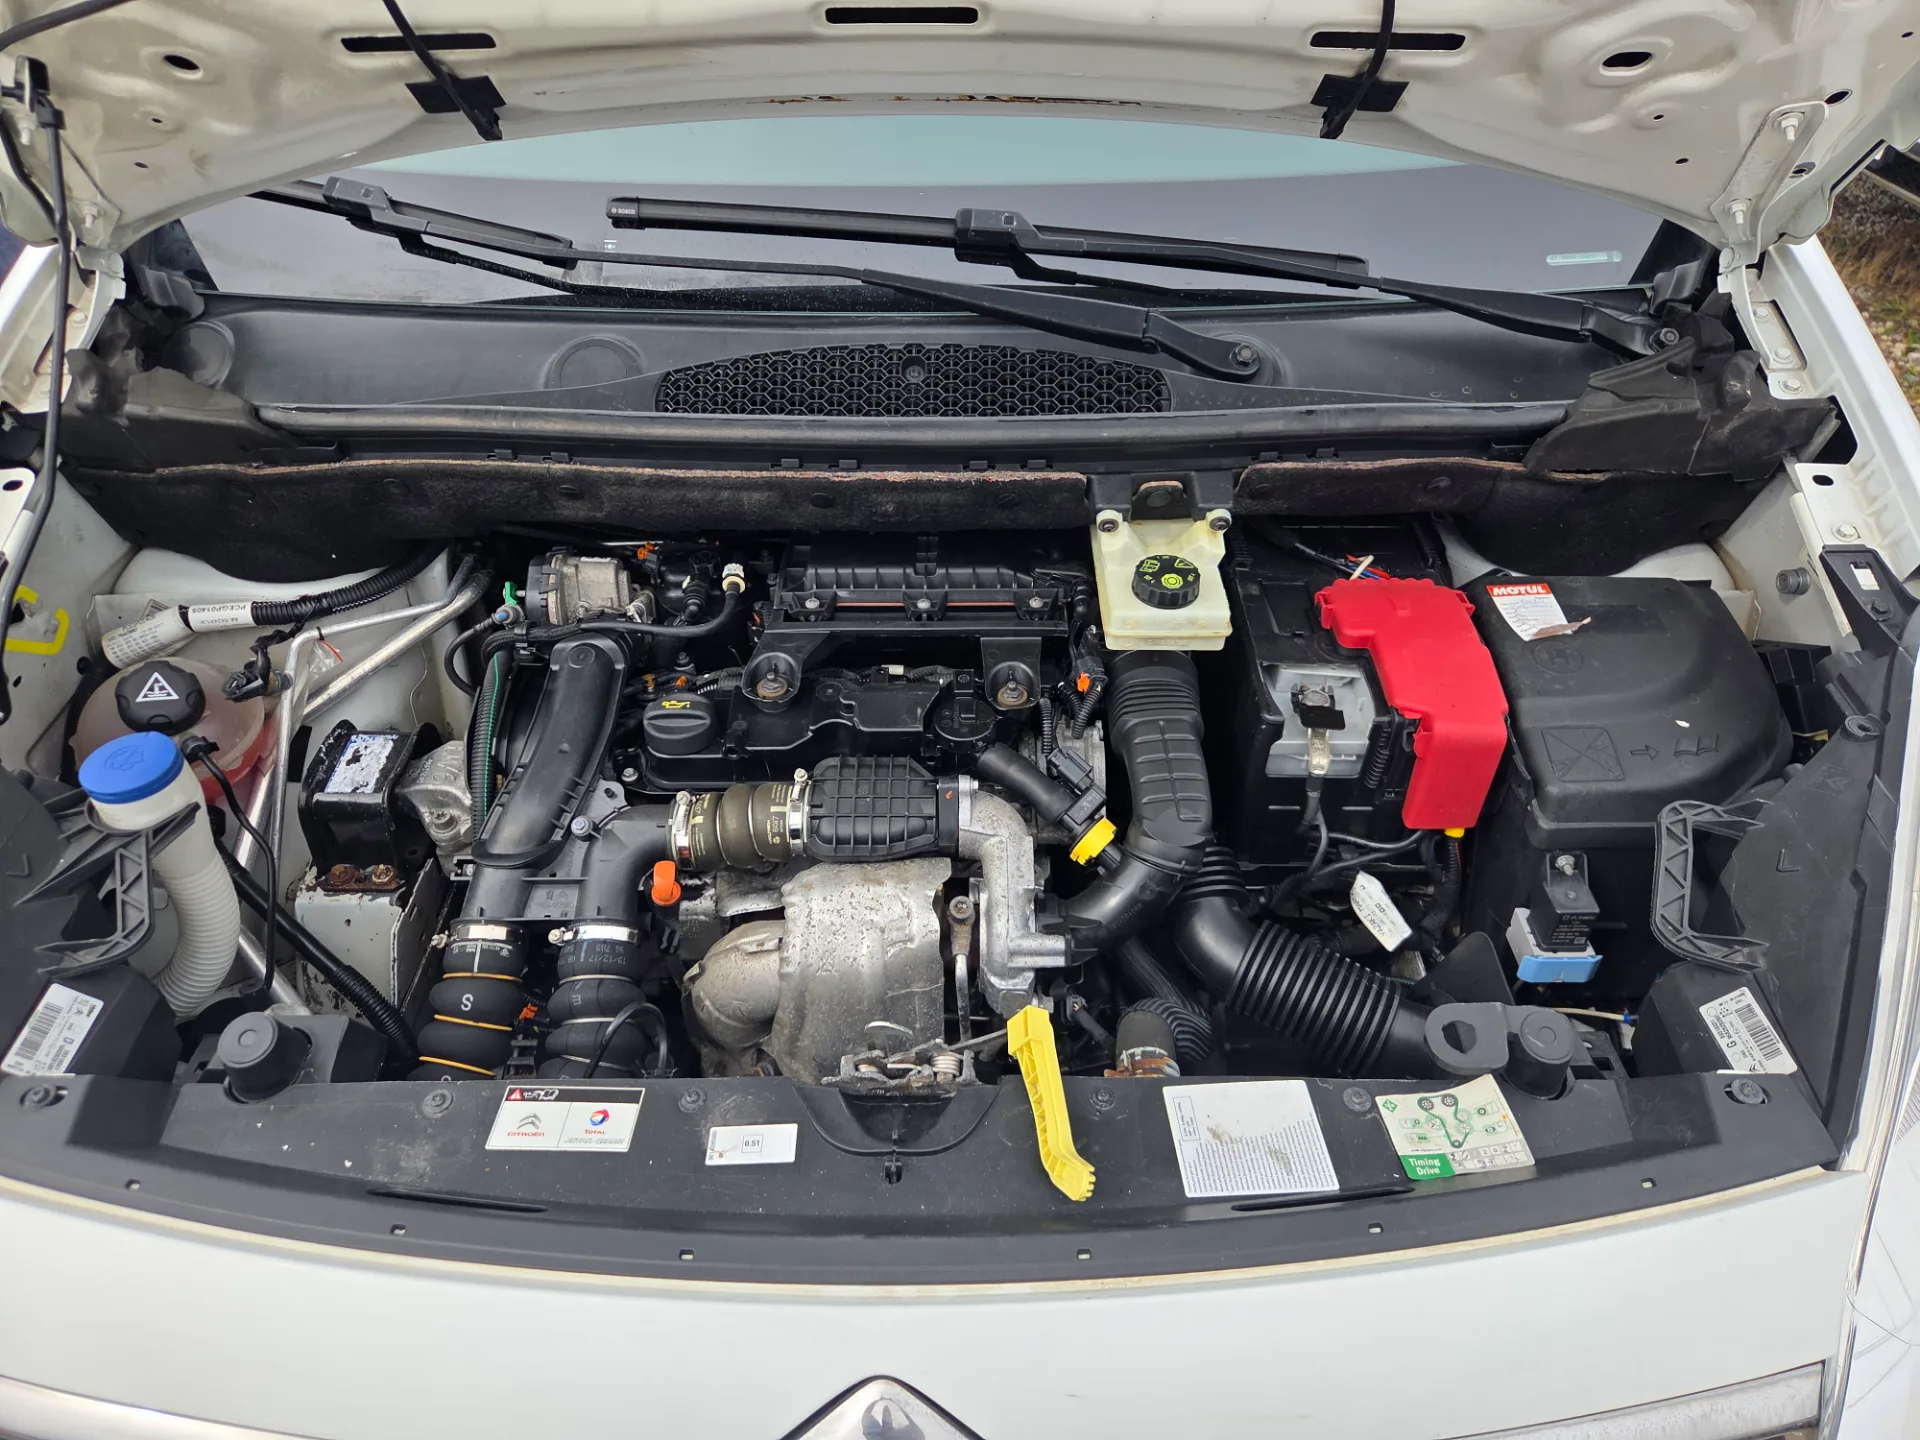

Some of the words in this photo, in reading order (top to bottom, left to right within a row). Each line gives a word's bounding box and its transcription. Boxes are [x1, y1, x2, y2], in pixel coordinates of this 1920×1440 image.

[1493, 585, 1547, 596] MOTUL
[1364, 913, 1386, 937] YAZAKI
[461, 993, 474, 1011] S
[1726, 1040, 1737, 1049] G
[1408, 1158, 1441, 1167] Timing
[1415, 1166, 1441, 1175] Drive
